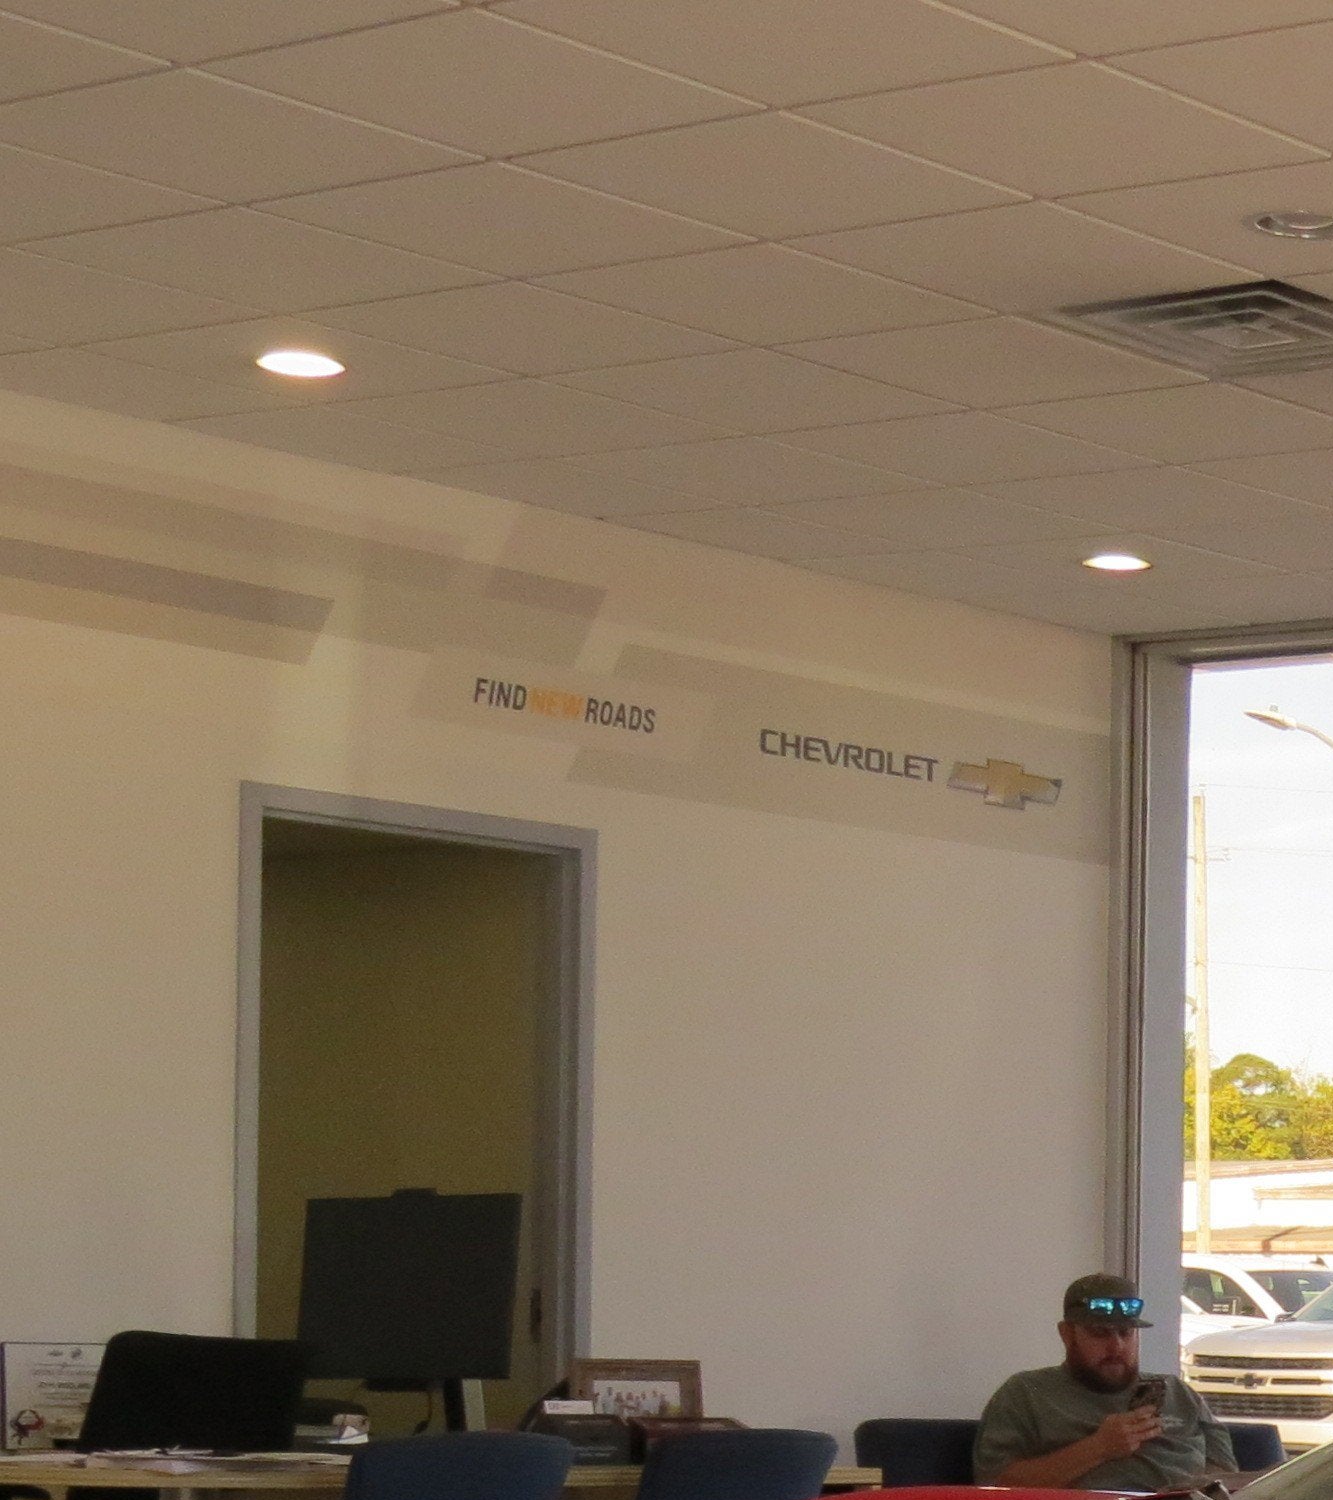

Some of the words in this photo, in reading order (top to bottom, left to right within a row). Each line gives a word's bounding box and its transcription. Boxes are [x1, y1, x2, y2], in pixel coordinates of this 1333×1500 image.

[474, 677, 527, 711] FIND
[584, 697, 656, 734] ROADS
[760, 728, 939, 782] CHEVROLET
